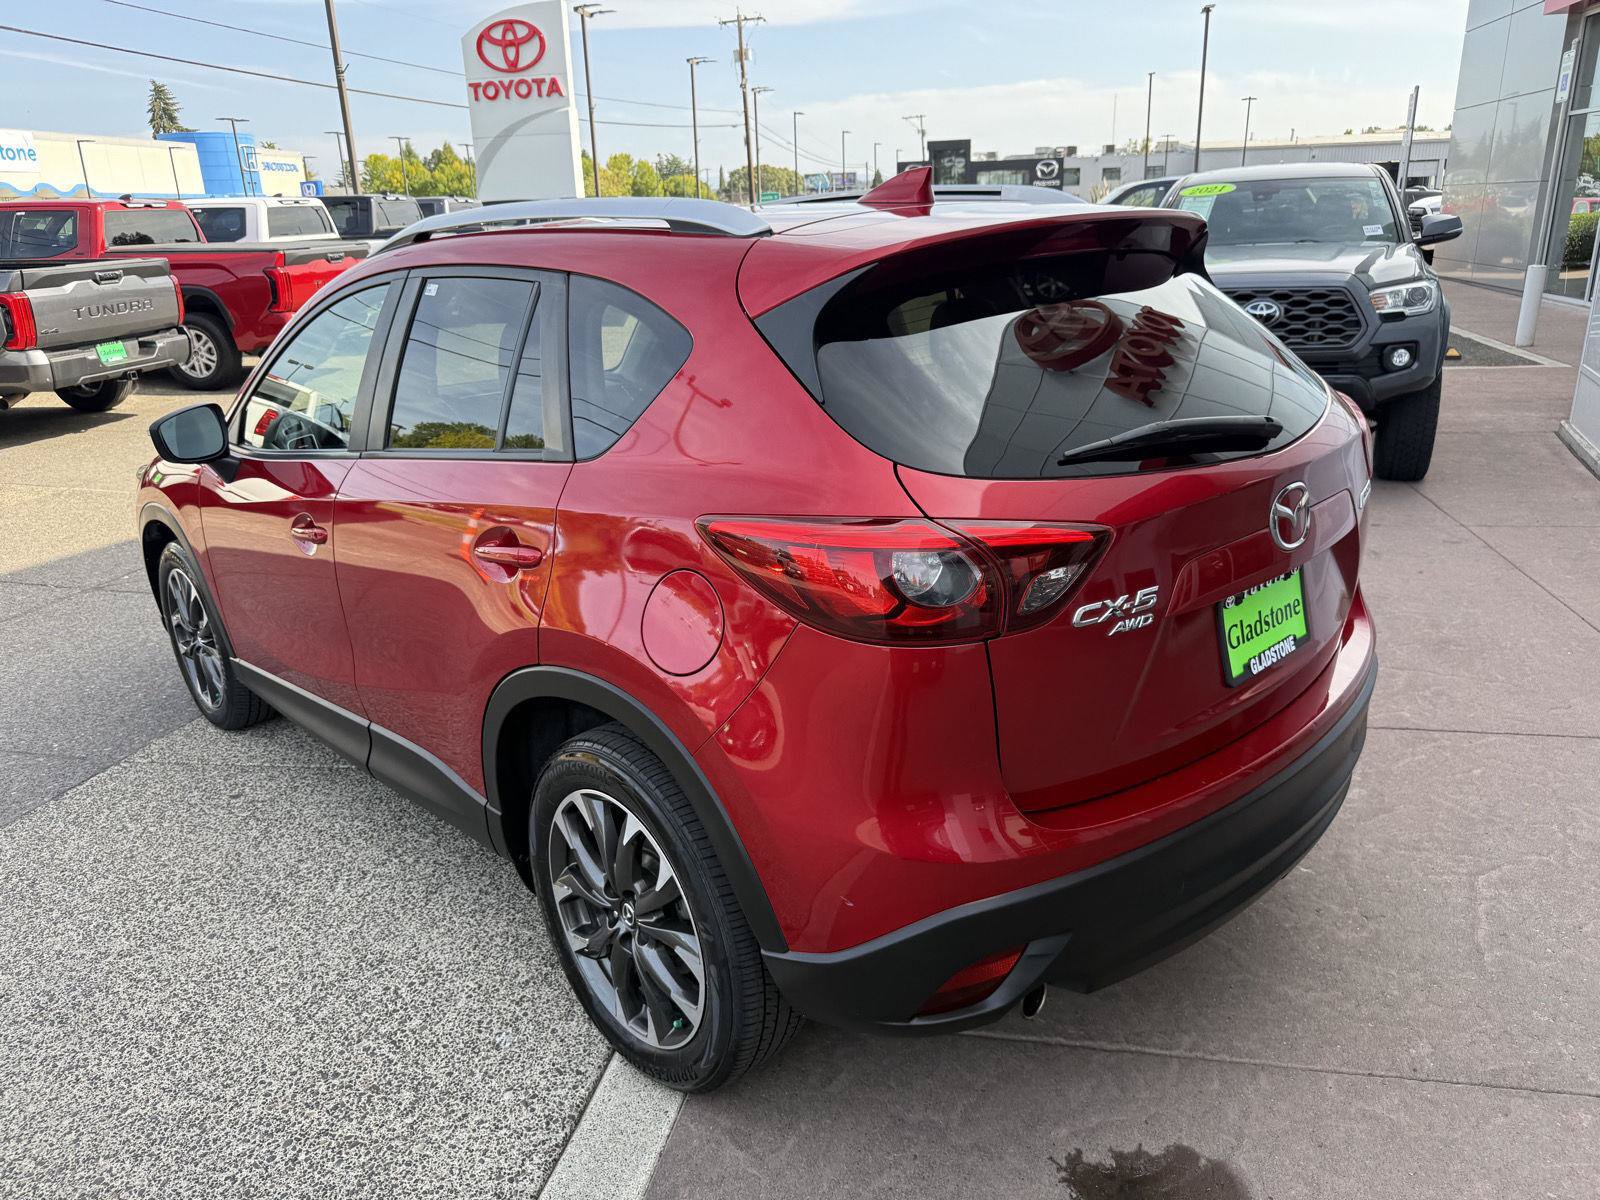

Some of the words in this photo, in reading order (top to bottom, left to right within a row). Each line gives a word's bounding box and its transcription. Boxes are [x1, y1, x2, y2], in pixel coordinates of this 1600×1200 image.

[468, 77, 566, 102] TOYOTA
[72, 299, 154, 320] TUNDRA
[1072, 585, 1159, 627] CX-5
[1107, 613, 1154, 636] AWD
[1227, 598, 1301, 650] Gladstone
[1250, 635, 1297, 675] GLADSTONE
